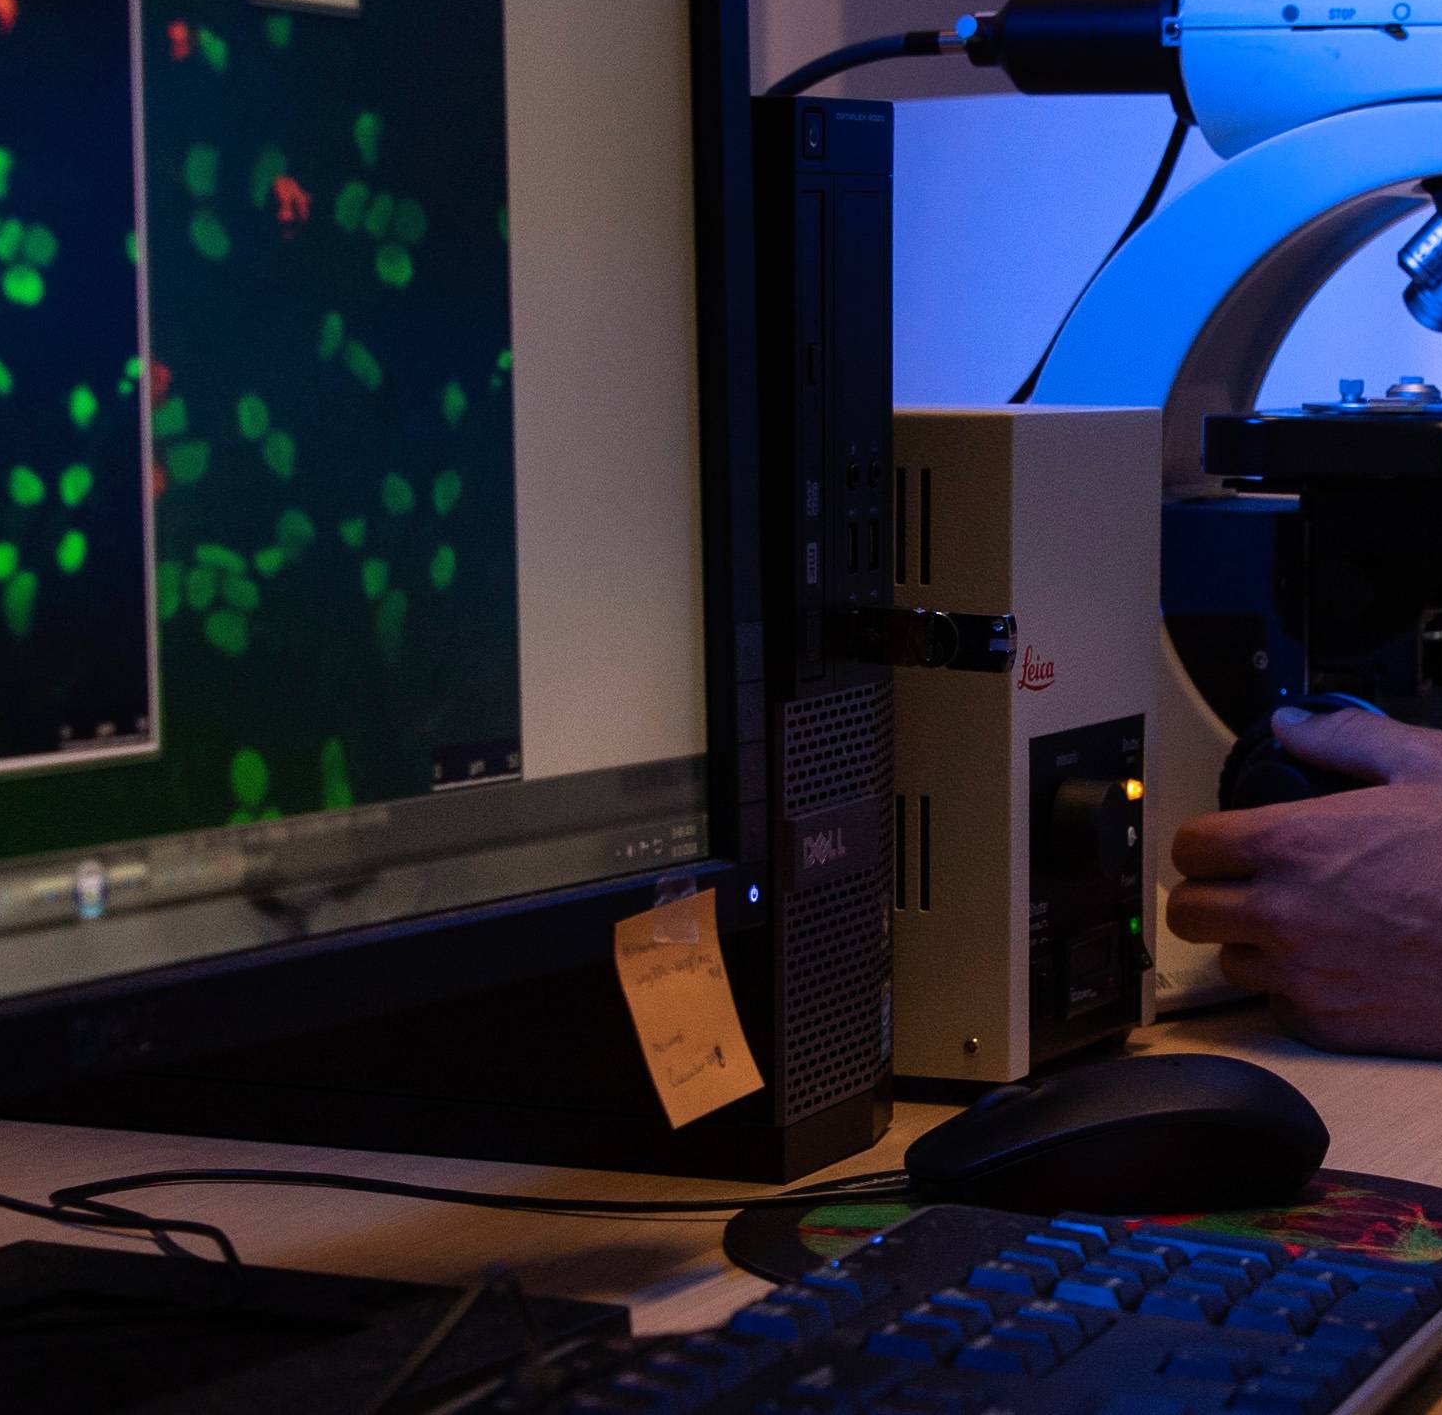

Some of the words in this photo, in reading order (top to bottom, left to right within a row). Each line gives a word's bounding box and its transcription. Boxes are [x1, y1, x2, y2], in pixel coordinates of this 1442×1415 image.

[1328, 8, 1356, 20] STOP
[1017, 645, 1055, 691] Leica
[802, 828, 847, 868] DELL
